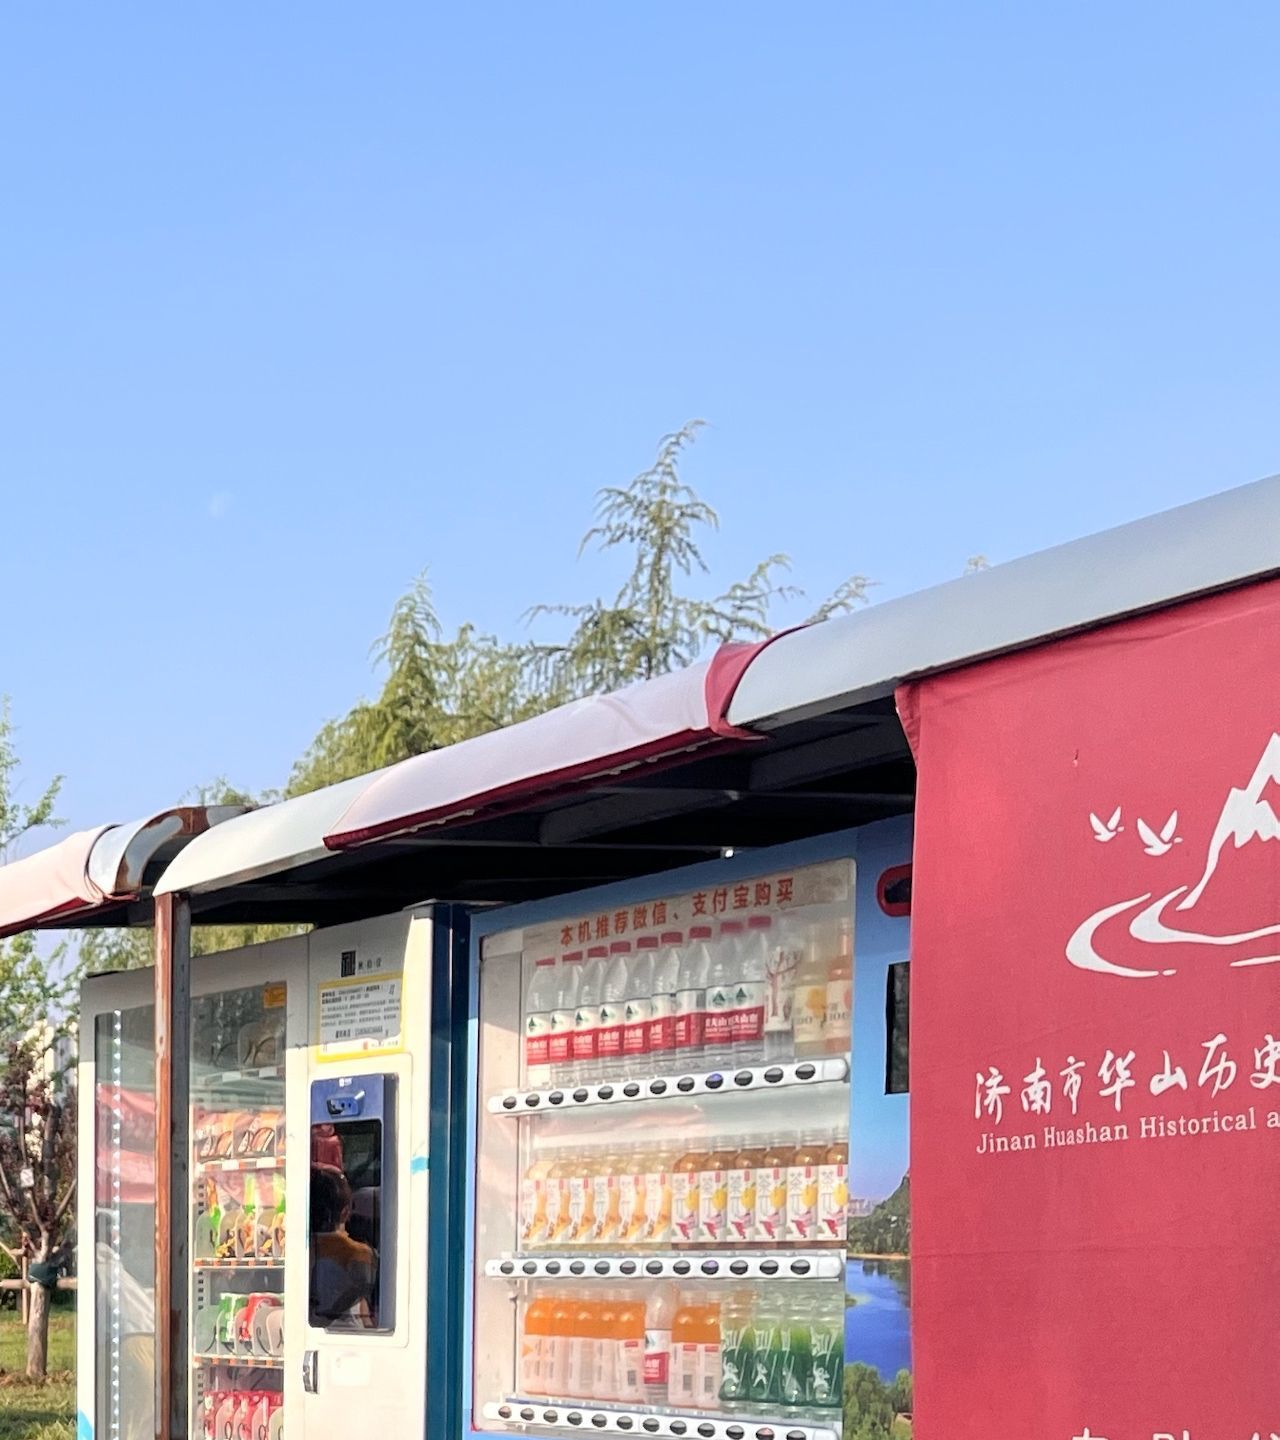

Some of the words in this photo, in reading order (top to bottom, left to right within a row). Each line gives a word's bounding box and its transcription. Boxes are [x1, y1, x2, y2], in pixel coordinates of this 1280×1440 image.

[561, 877, 794, 947] 本机推荐微信、支付宝购买
[976, 1133, 1036, 1154] Jinan
[1044, 1122, 1128, 1148] Huashan
[1140, 1107, 1256, 1138] Historical
